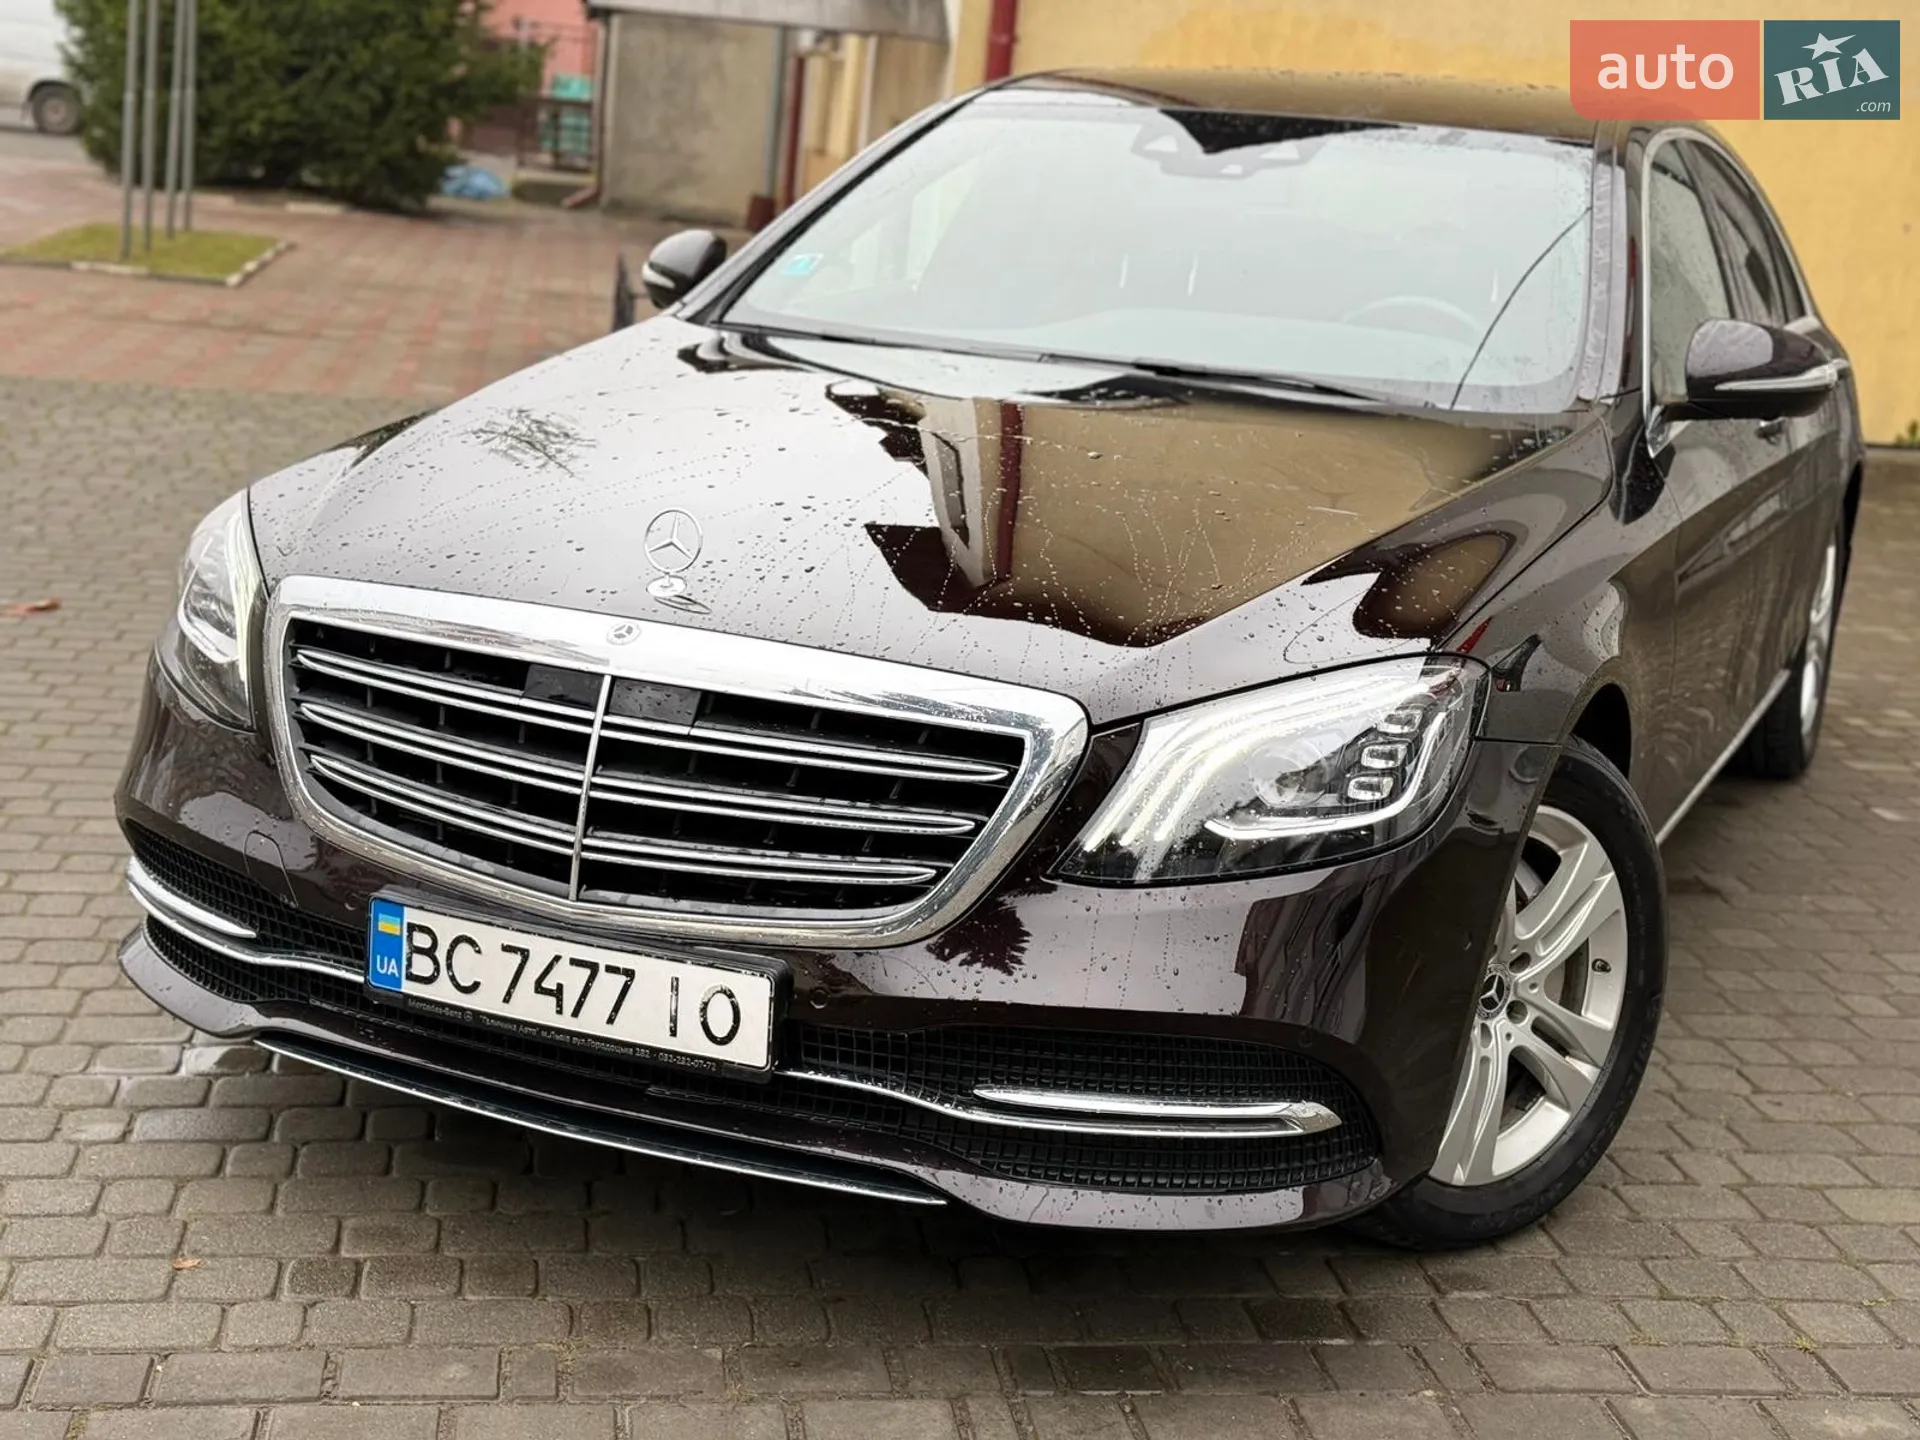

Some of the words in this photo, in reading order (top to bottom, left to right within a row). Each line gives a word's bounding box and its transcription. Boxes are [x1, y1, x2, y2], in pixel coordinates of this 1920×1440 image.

[376, 955, 400, 978] UA
[406, 923, 482, 993] BC
[501, 943, 636, 1025] 7477
[669, 976, 741, 1046] IO
